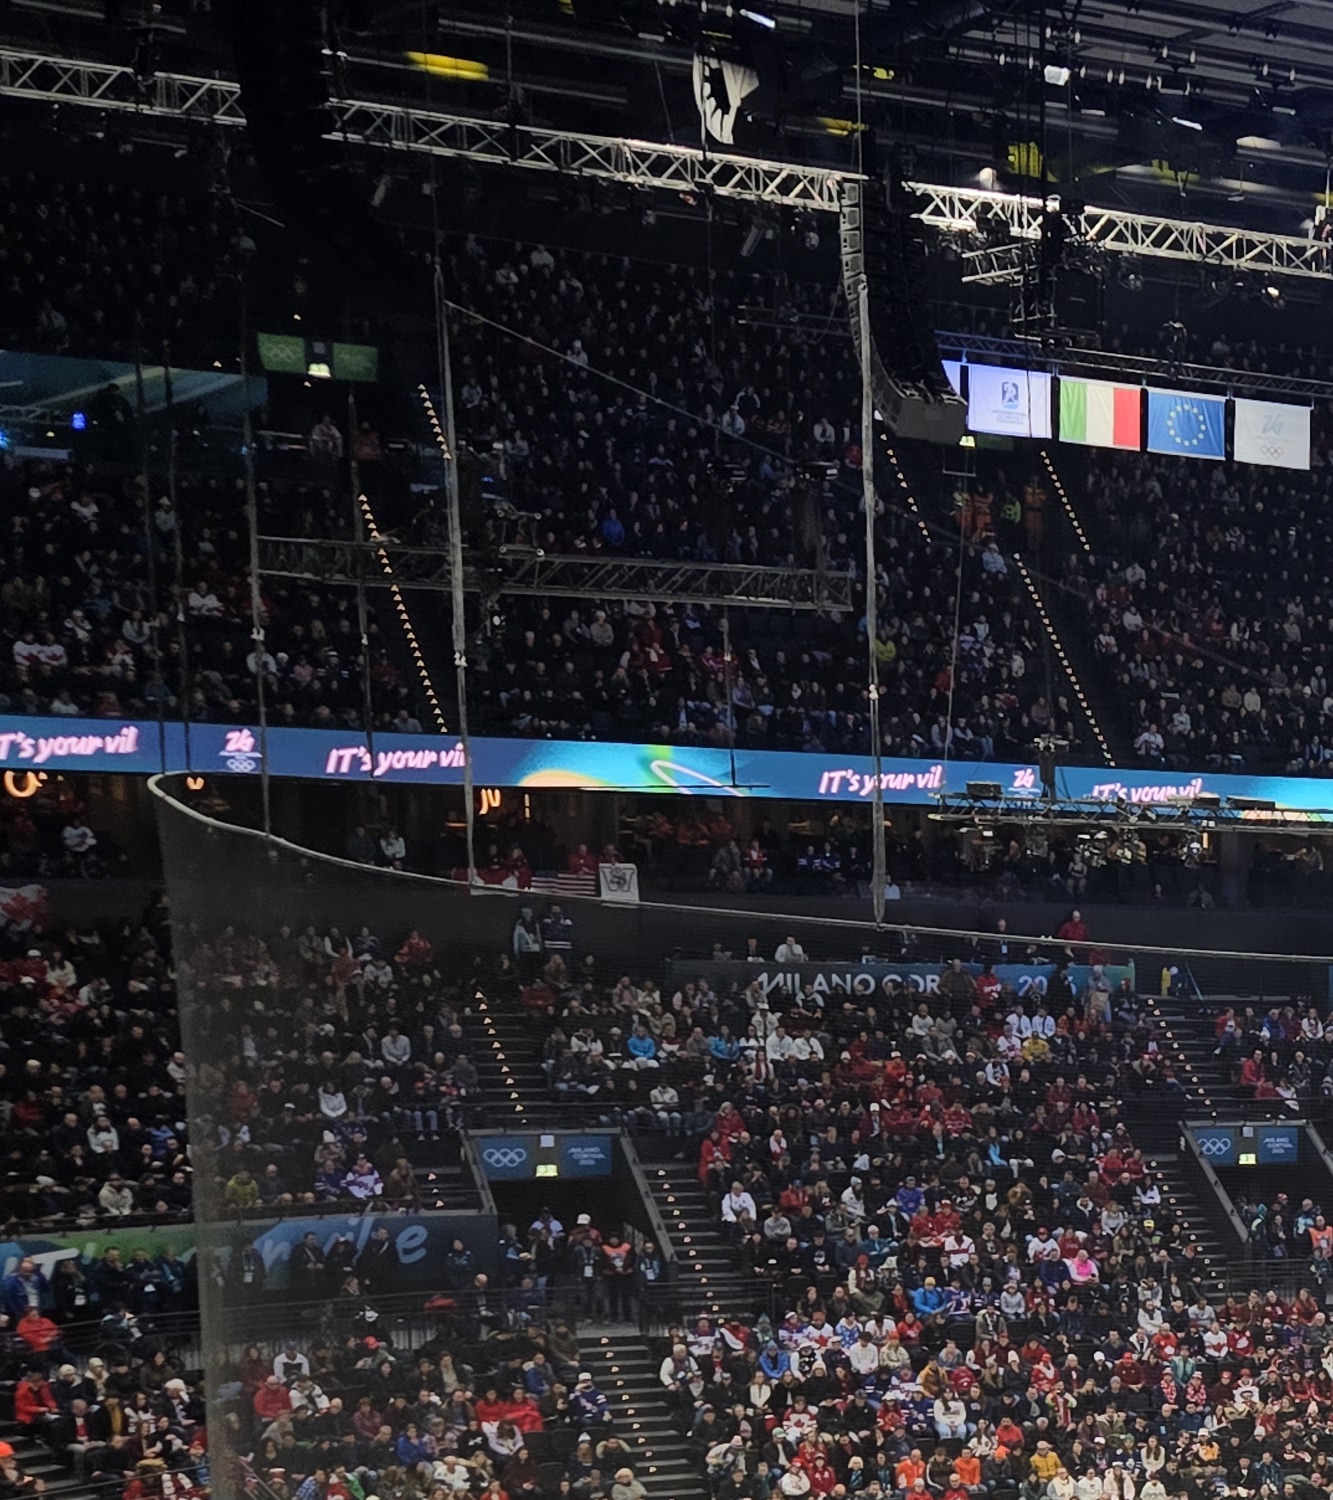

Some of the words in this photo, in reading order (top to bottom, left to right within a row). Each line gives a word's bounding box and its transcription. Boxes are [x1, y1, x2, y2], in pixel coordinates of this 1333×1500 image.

[33, 736, 102, 763] your
[104, 726, 138, 754] vil
[326, 746, 372, 774] IT's
[374, 750, 437, 776] your
[818, 769, 860, 794] IT's
[860, 773, 914, 796] your
[917, 765, 944, 789] vil
